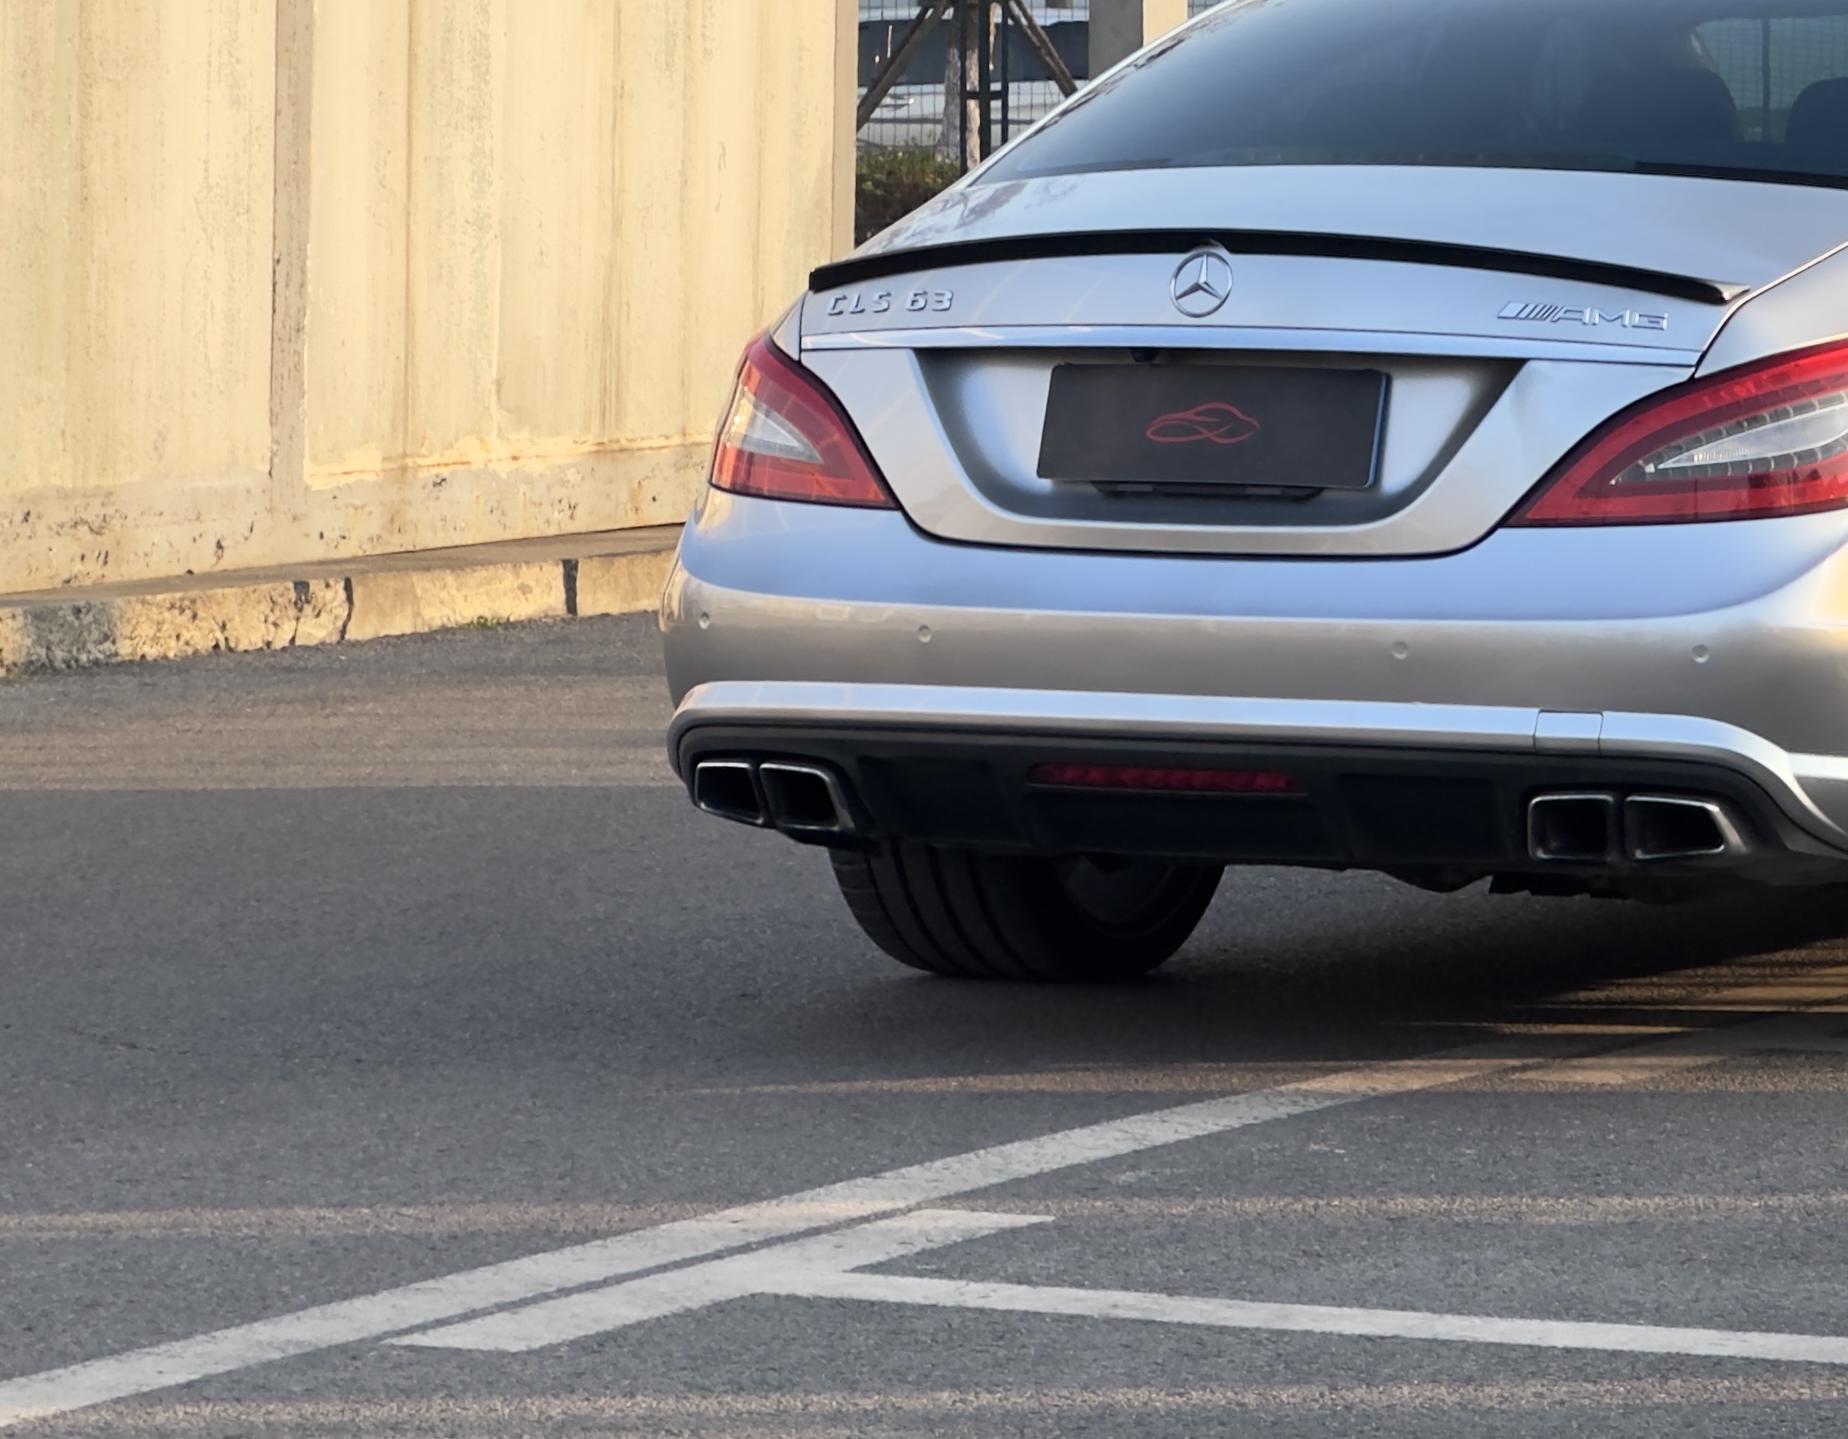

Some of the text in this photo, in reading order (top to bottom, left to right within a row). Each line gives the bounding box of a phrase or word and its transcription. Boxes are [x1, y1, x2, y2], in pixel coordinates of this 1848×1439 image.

[827, 289, 954, 316] CLS 63
[1550, 305, 1669, 331] AMG
